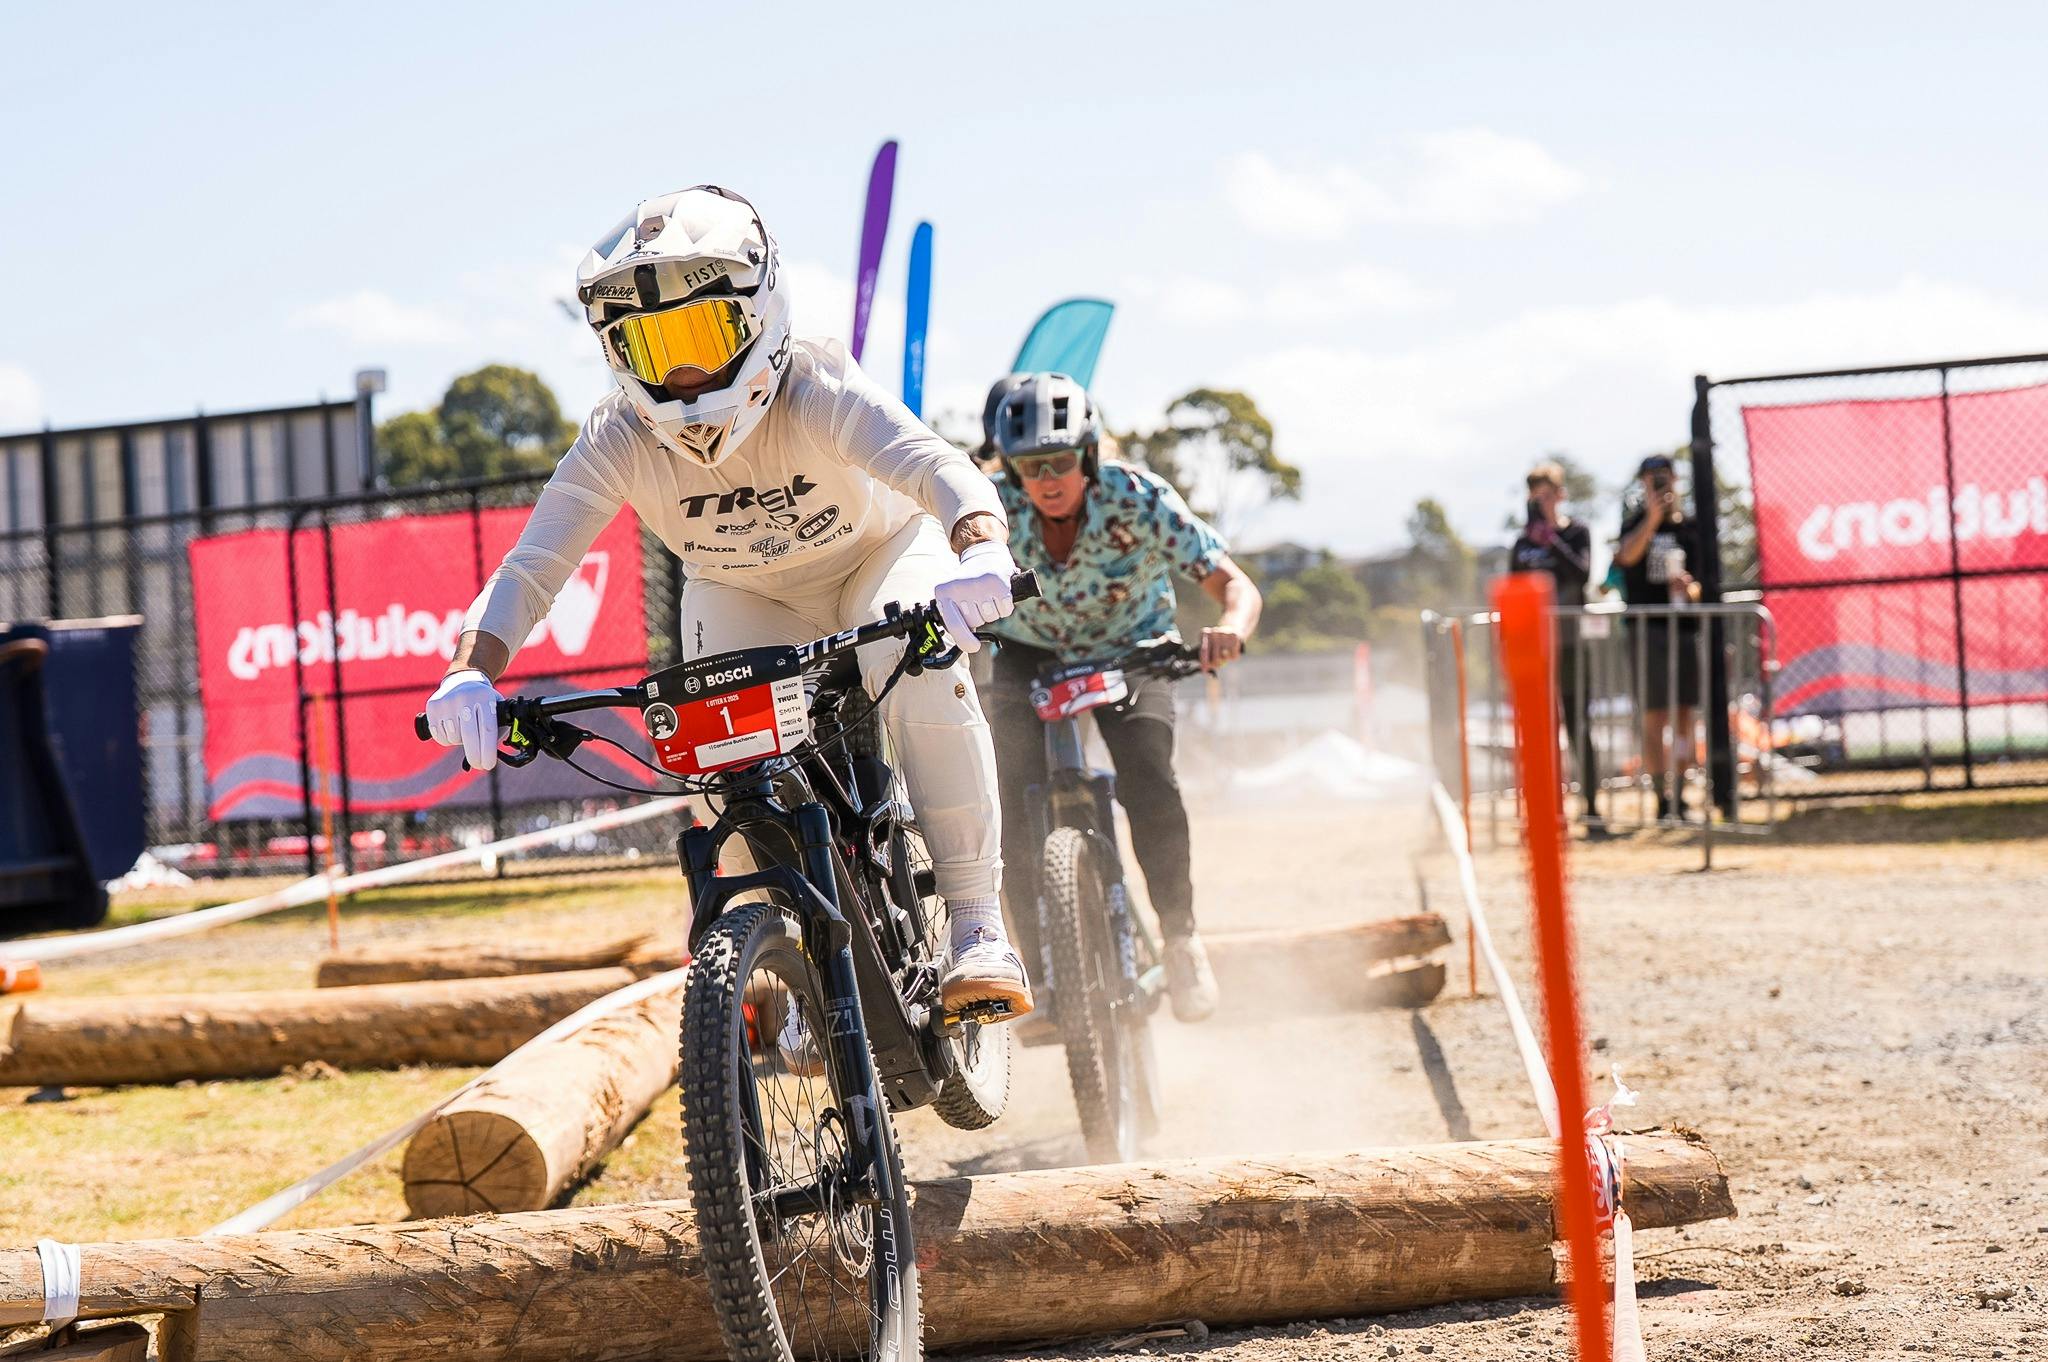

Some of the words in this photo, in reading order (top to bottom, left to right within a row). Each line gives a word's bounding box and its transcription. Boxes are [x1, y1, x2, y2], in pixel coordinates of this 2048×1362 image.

[684, 263, 717, 288] FIST
[596, 285, 635, 299] RIDEWRAP
[680, 475, 818, 518] TREK
[730, 518, 758, 531] boost
[802, 511, 834, 538] BELL
[814, 523, 853, 547] DEITY
[697, 544, 737, 552] MAXXIS
[751, 540, 772, 553] RIDE
[764, 544, 788, 557] WRAP
[796, 626, 860, 664] EITY
[705, 665, 753, 687] BOSCH
[782, 682, 798, 690] BOSCH
[777, 693, 799, 703] THULE
[779, 706, 801, 715] SMITH
[720, 706, 733, 735] 1
[782, 729, 804, 738] MAXXIS
[828, 1009, 859, 1036] Z1
